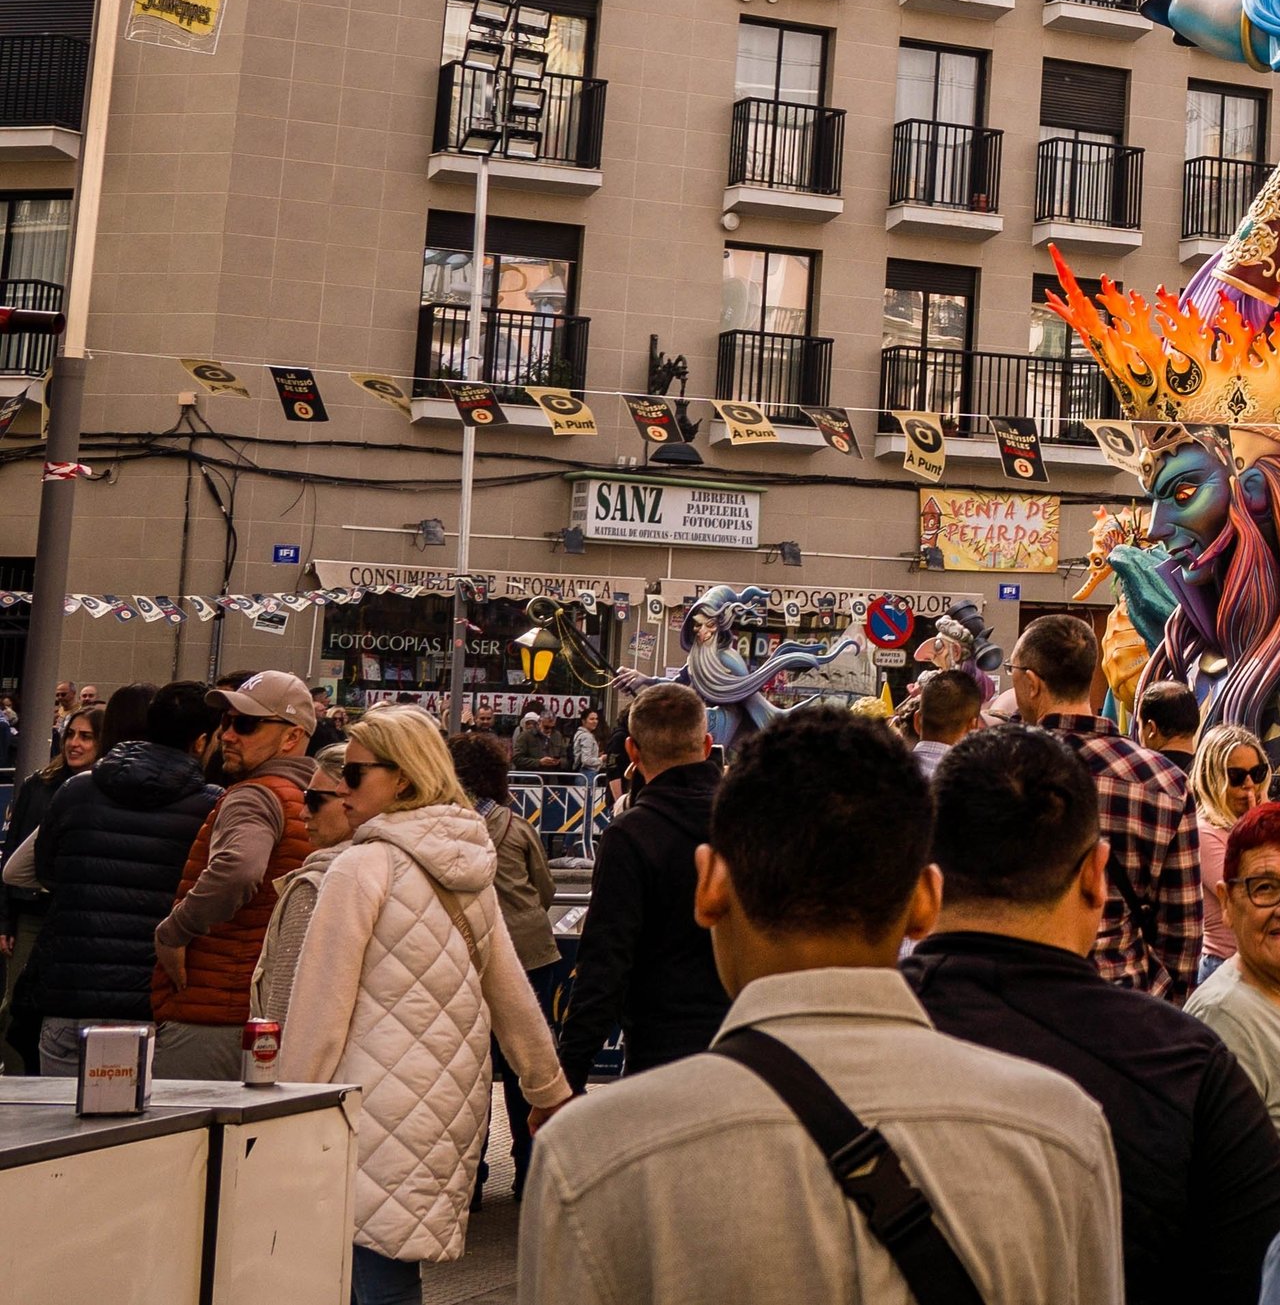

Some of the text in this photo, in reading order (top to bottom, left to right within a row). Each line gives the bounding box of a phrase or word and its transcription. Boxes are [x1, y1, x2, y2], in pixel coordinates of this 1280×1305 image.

[565, 419, 594, 429] Punt
[746, 429, 776, 438] Punt
[918, 456, 943, 477] Punt
[595, 483, 663, 524] SANZ
[691, 491, 746, 505] LIBRERIA
[686, 503, 750, 518] PAPELERIA
[950, 498, 1052, 520] VENTA DE
[682, 516, 752, 531] FOTOCOPIAS
[594, 526, 753, 545] MATERIAL DE OFICINAS ENCUADERNACIONES FAX
[946, 523, 1053, 544] PETARDOS
[350, 567, 457, 592] CONSUMIBLE
[505, 576, 612, 600] INFORMATICA
[903, 595, 952, 613] OLOR
[330, 633, 441, 652] FOTOCOPIAS
[89, 1066, 134, 1080] alaçant
